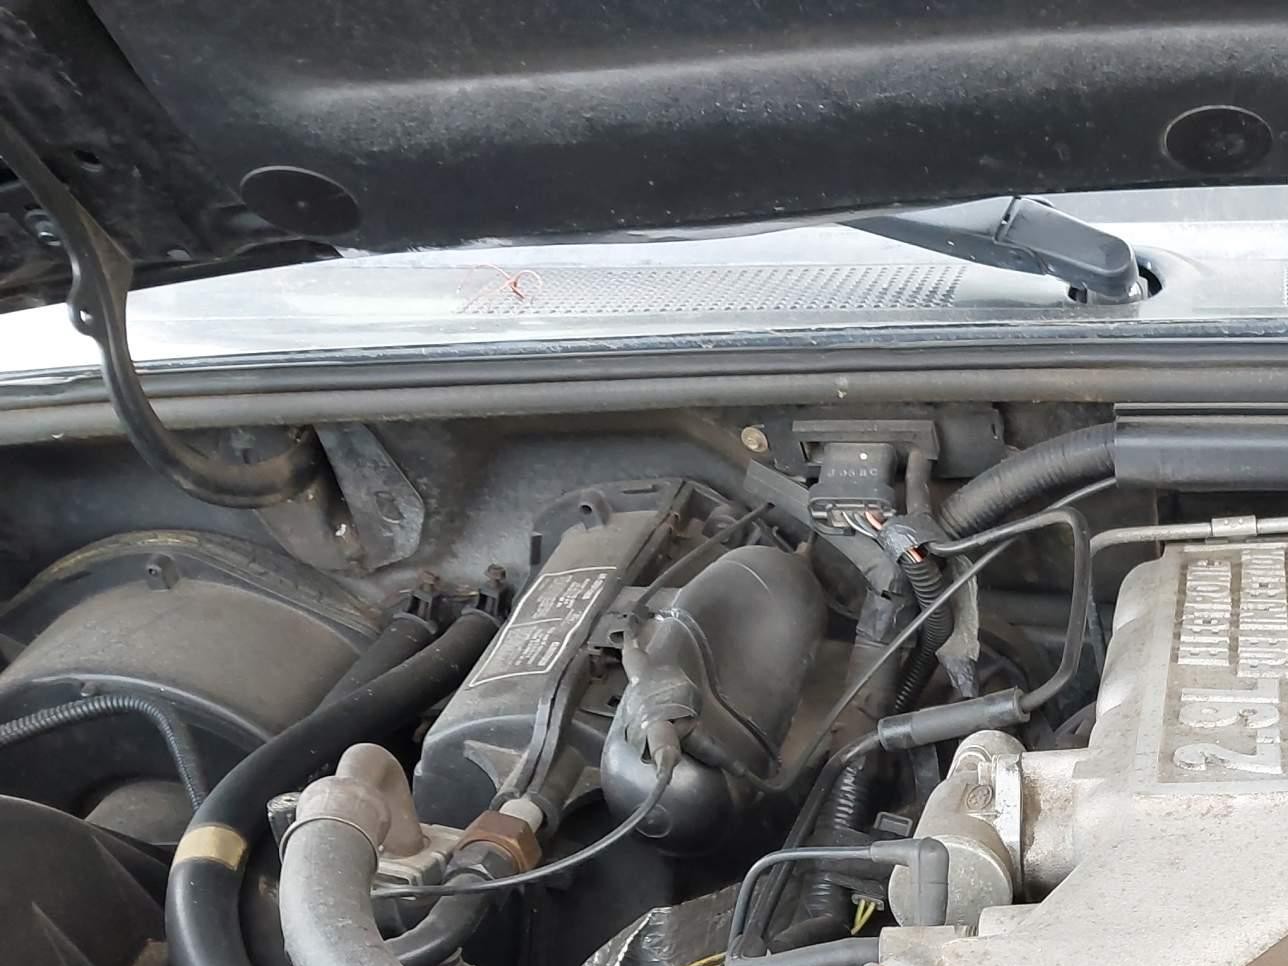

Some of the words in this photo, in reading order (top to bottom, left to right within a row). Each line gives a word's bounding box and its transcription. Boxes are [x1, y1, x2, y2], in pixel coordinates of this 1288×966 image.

[1177, 559, 1232, 667] ELECTRONIC
[1239, 550, 1288, 630] INJECTION
[1172, 678, 1283, 775] 2.9L
